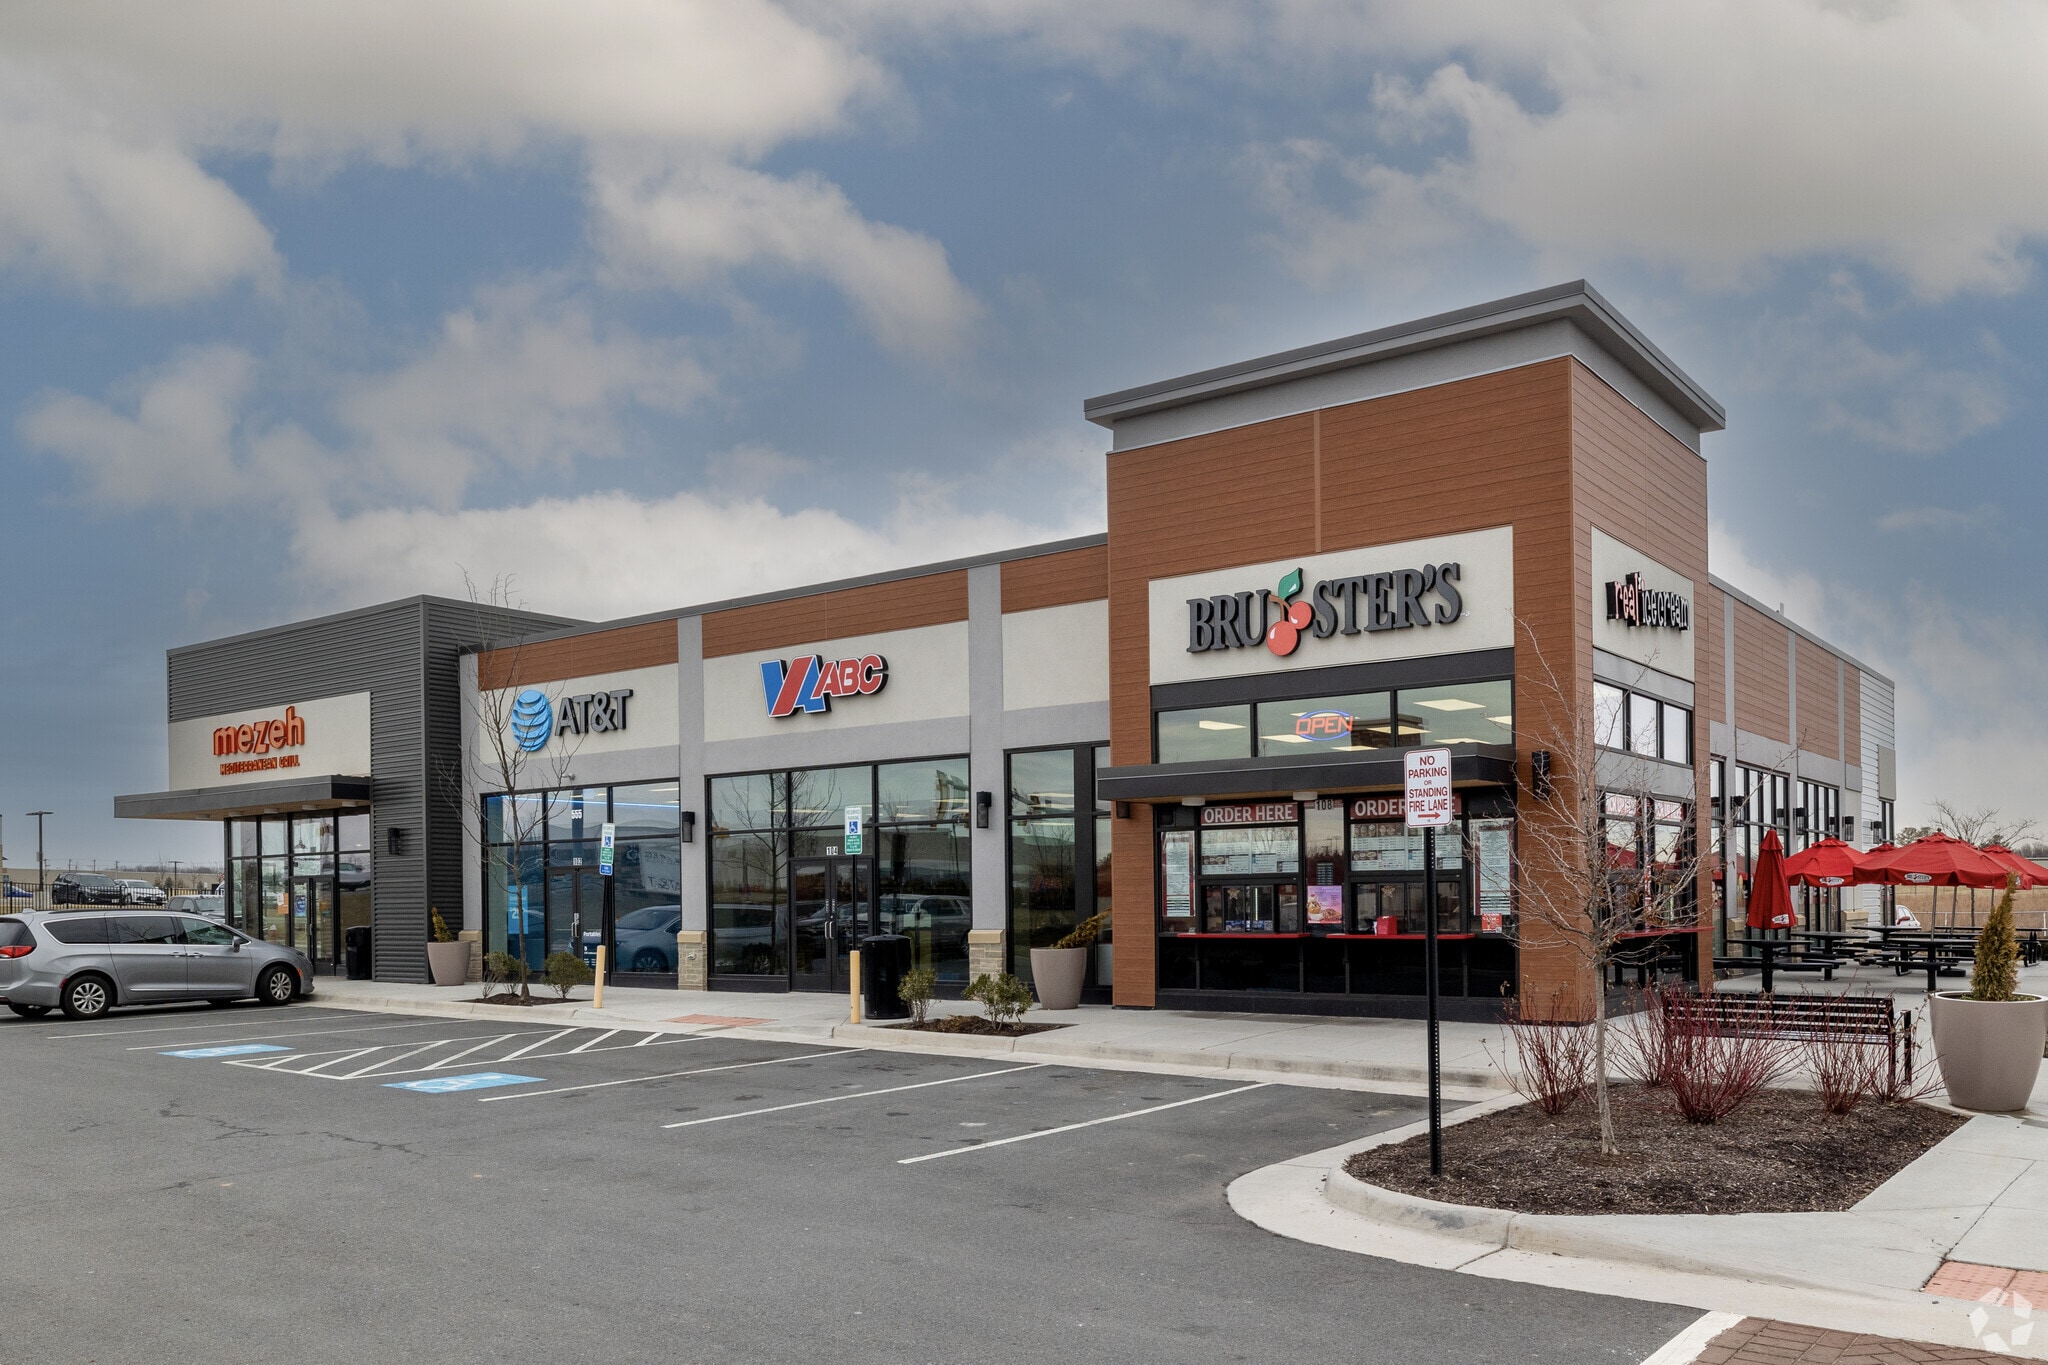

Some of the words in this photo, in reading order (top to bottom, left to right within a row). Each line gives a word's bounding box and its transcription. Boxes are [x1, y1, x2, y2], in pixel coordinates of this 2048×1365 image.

[1187, 562, 1463, 655] BRUSTER'S
[1607, 572, 1641, 627] real
[810, 653, 888, 698] ABC
[555, 689, 634, 736] AT&T
[213, 705, 305, 756] mezeh
[1295, 715, 1354, 735] OPEN
[220, 757, 277, 776] MEDITERRANEAN
[279, 754, 300, 769] GRILL
[1419, 755, 1435, 766] NO
[1408, 766, 1448, 779] PARKING
[1408, 786, 1448, 799] STANDING
[571, 809, 583, 819] 555
[1204, 806, 1252, 823] ORDER
[1255, 804, 1294, 821] HERE
[1315, 799, 1333, 811] 108
[1408, 800, 1425, 813] FIRE
[1428, 798, 1448, 811] LANE
